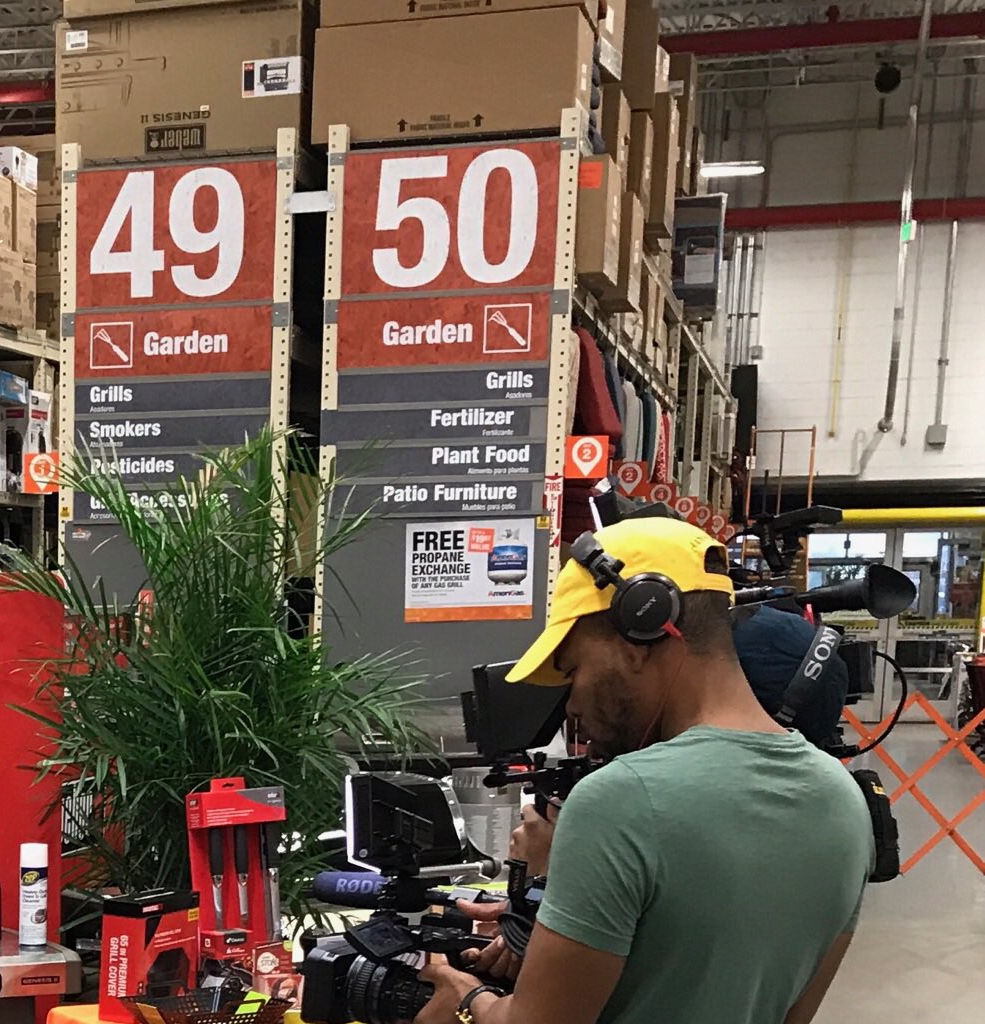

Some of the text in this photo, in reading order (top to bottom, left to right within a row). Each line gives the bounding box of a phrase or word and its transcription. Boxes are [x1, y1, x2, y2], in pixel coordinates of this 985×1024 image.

[153, 111, 212, 123] GENESIS
[160, 128, 202, 149] weber
[372, 148, 539, 288] 50
[90, 167, 245, 298] 49
[382, 319, 474, 346] Garden
[143, 331, 229, 357] Garden
[486, 371, 534, 390] Grills
[89, 385, 133, 403] Grills
[430, 408, 515, 427] Fertilizer
[89, 420, 162, 438] Smokers
[431, 444, 530, 465] Plant Food
[582, 448, 592, 460] 2
[625, 472, 633, 482] 2
[382, 483, 518, 503] Patio Furniture
[545, 482, 562, 492] FIRE
[412, 530, 465, 552] FREE
[412, 551, 465, 564] PROPANE
[411, 563, 471, 576] EXCHANGE
[636, 596, 657, 617] SONY
[119, 934, 129, 947] 65
[107, 936, 120, 997] GRILL COVER
